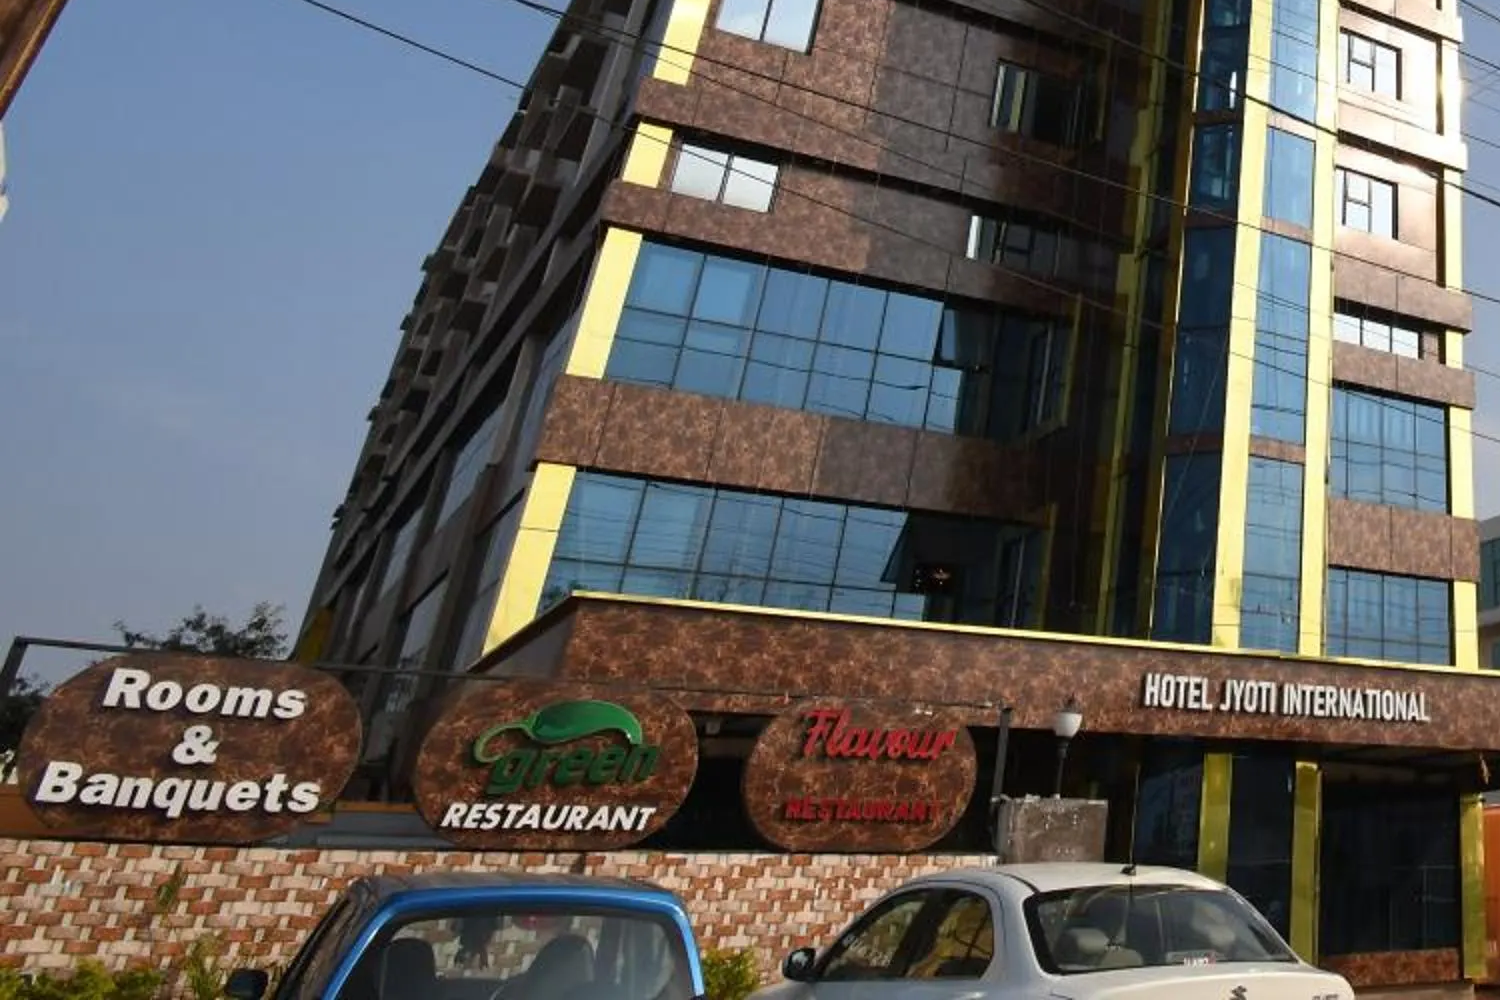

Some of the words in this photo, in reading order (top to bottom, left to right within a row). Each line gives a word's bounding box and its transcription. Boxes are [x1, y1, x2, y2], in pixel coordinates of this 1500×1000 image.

[103, 668, 307, 719] Rooms
[1144, 672, 1213, 710] HOTEL
[1219, 678, 1277, 714] JYOTI
[1282, 683, 1430, 723] INTERNATIONAL
[171, 724, 220, 766] &
[801, 706, 959, 761] Flavour
[35, 760, 321, 818] Banquets
[484, 744, 662, 796] green
[440, 802, 657, 831] RESTAURANT
[784, 795, 943, 823] RESTAURANT
